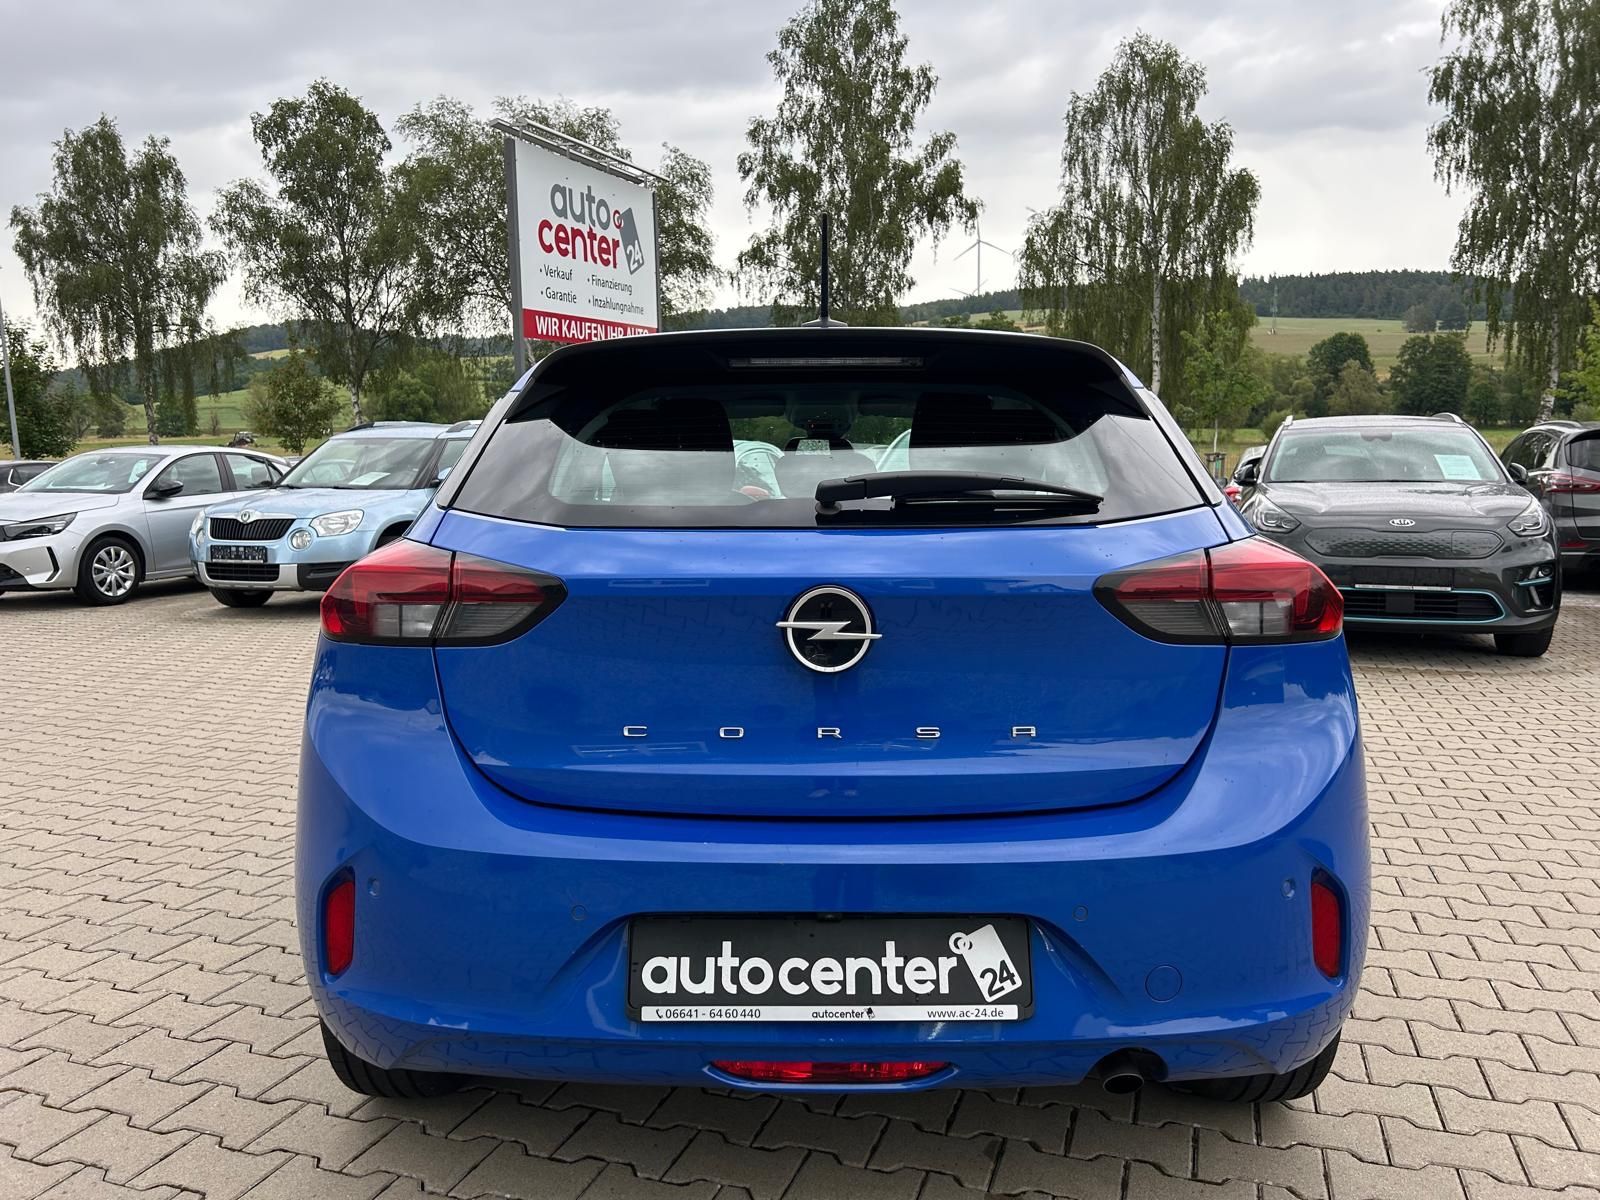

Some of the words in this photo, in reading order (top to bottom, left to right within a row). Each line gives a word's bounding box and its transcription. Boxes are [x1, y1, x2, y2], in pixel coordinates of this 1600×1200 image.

[550, 183, 611, 230] auto
[537, 219, 620, 269] center
[627, 241, 643, 268] 24
[543, 264, 573, 281] Verkauf
[591, 274, 632, 295] Finanzierung
[545, 287, 577, 304] Garantie
[592, 296, 644, 314] Inzahlungnahme
[535, 315, 560, 337] WIR
[561, 319, 605, 341] KAUFEN
[622, 725, 1037, 739] CORSA
[641, 940, 957, 995] autocenter
[979, 959, 1017, 997] 24
[665, 1009, 698, 1018] 06641
[811, 1010, 864, 1018] autocenter
[927, 1008, 1004, 1018] www.ac-24.de
